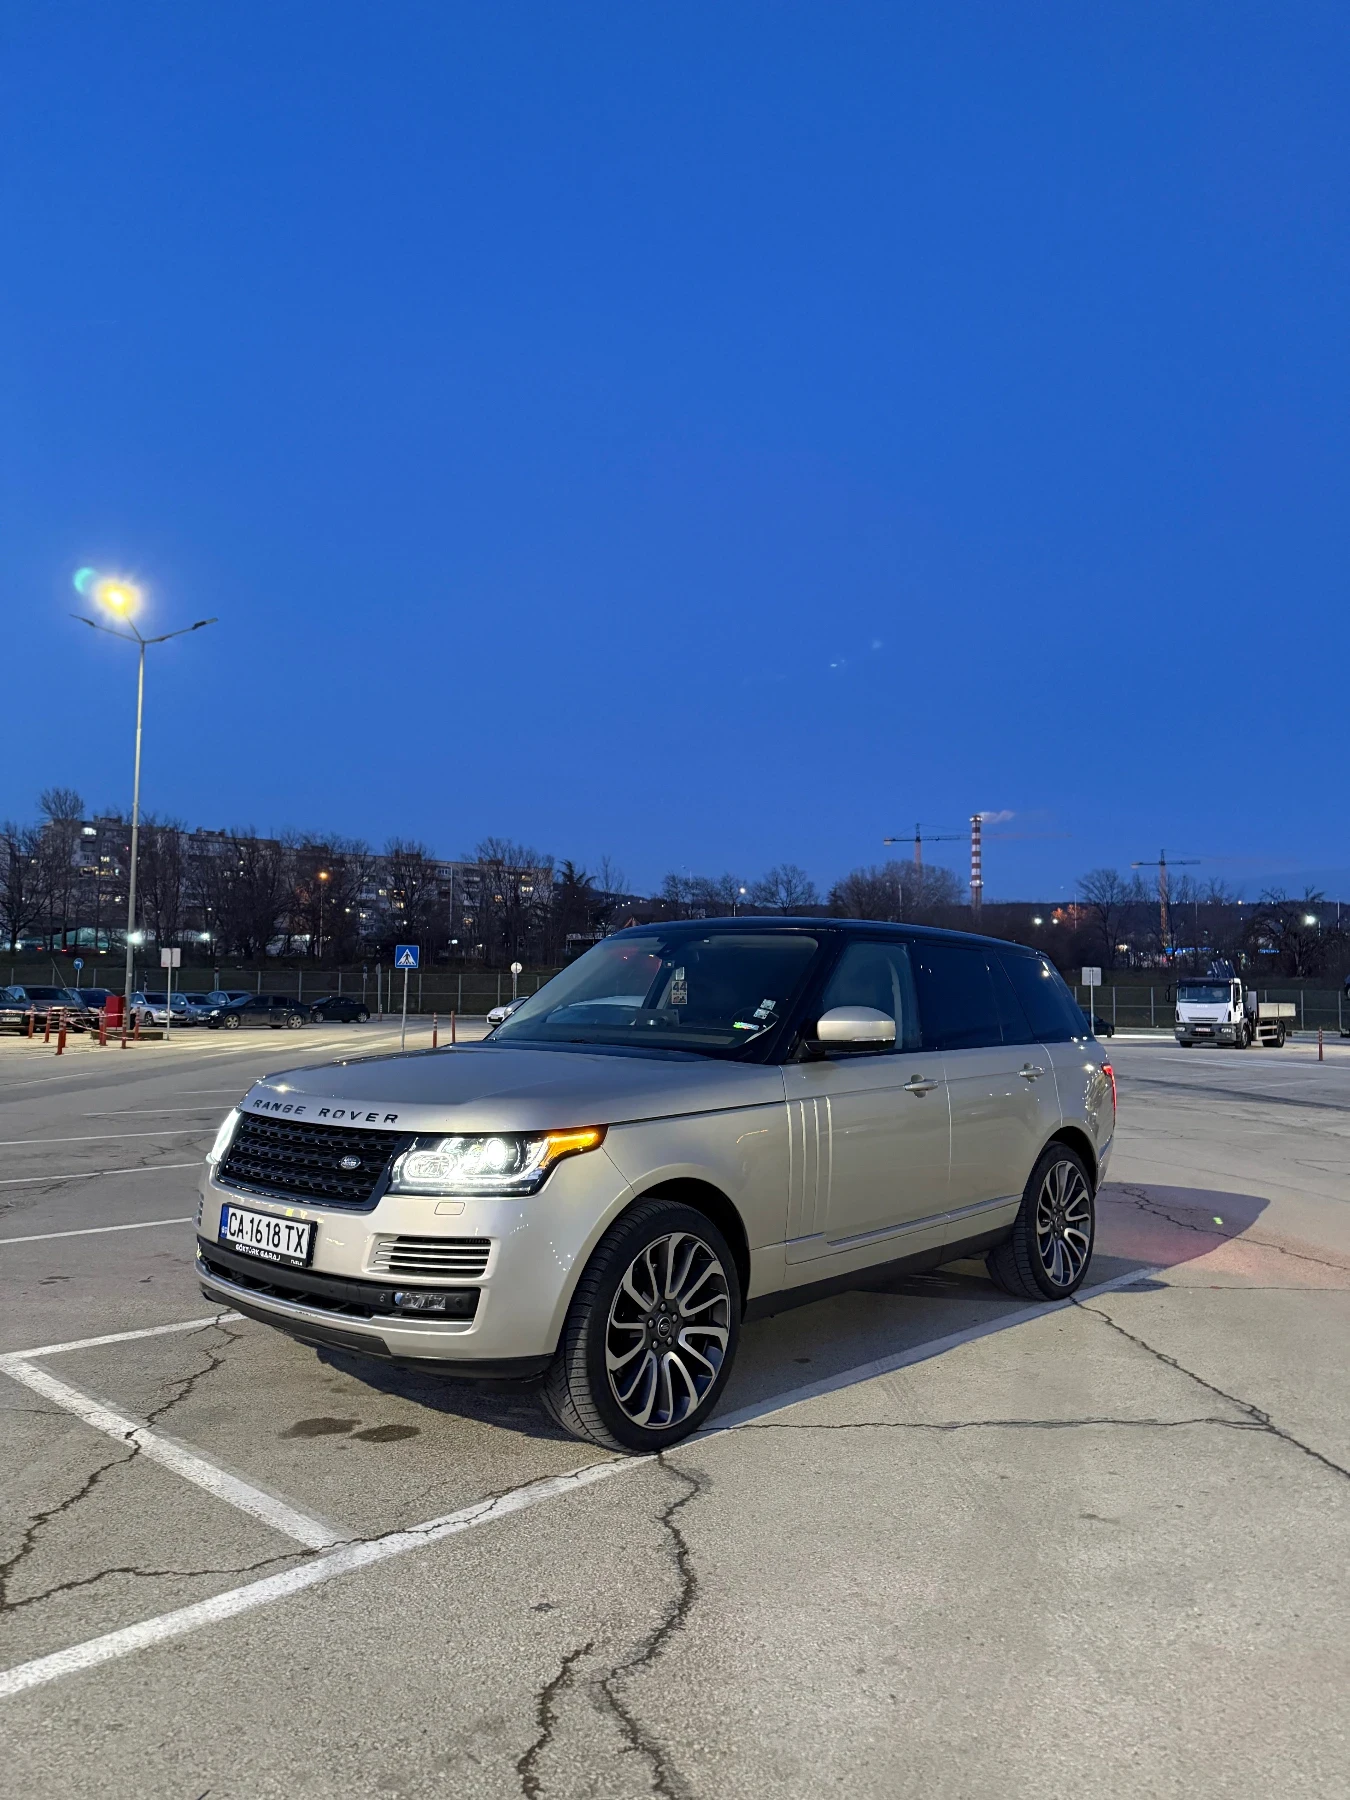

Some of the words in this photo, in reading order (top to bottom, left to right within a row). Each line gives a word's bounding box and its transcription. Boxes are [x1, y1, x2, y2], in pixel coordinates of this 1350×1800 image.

[673, 981, 687, 992] 44
[252, 1099, 306, 1115] RANGE
[317, 1107, 399, 1124] ROVER
[259, 1250, 281, 1262] GARAJ
